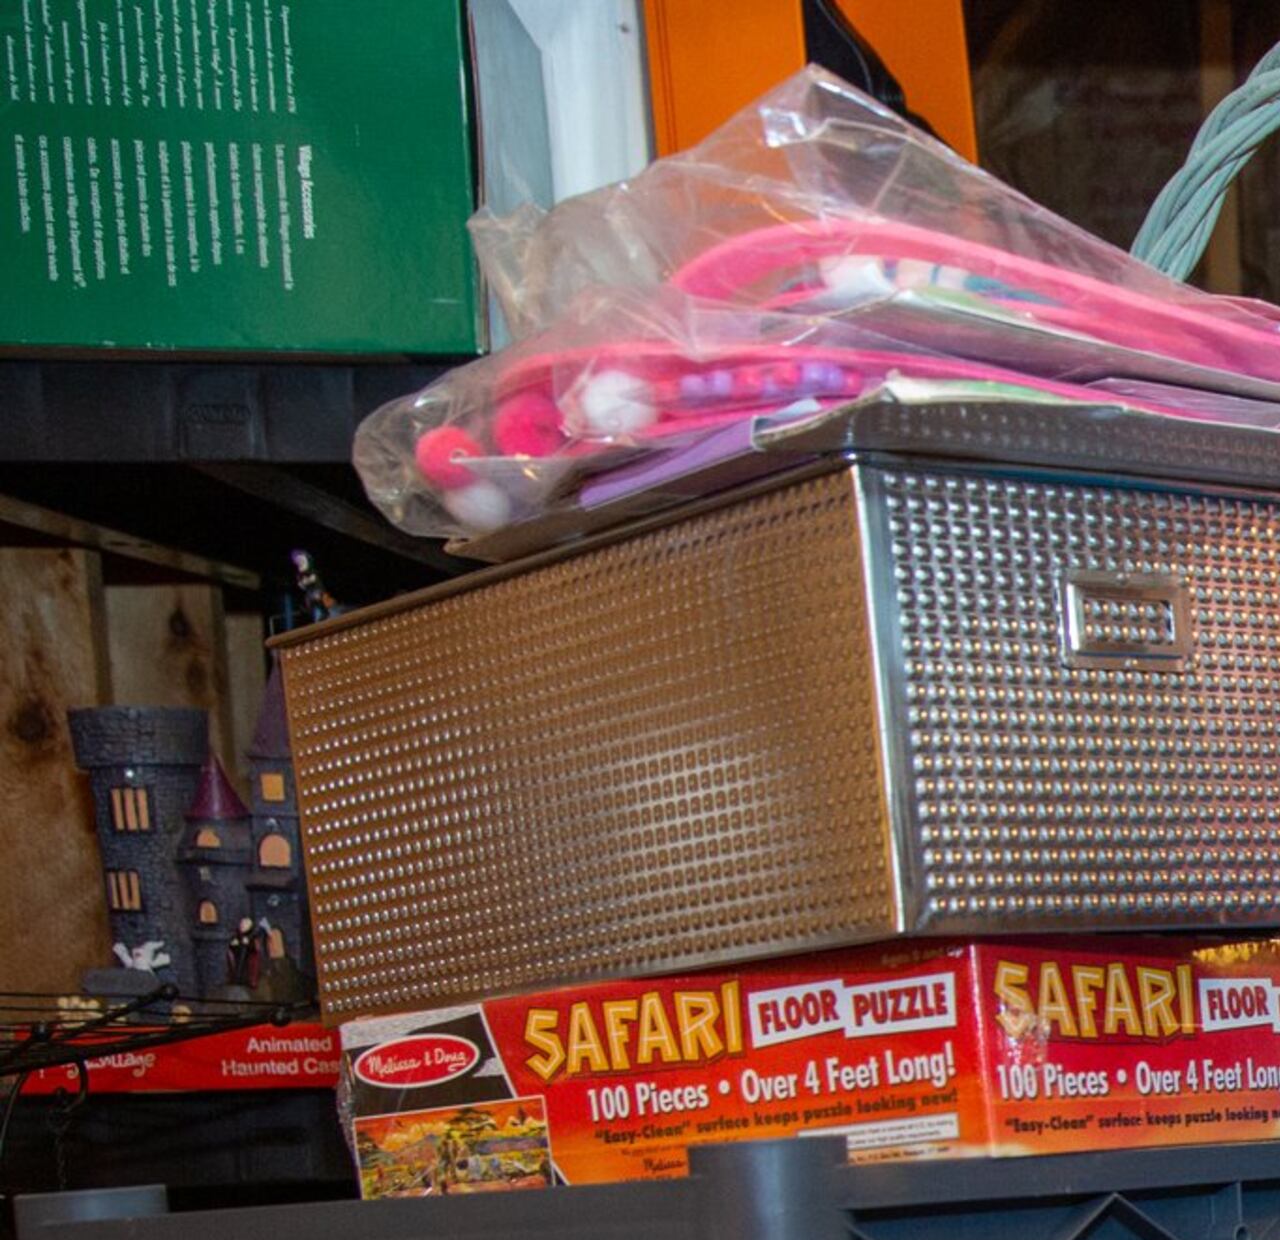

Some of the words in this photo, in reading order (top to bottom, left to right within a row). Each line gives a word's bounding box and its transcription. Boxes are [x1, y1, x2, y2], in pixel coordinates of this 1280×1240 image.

[994, 961, 1195, 1039] SAFARI
[1206, 986, 1270, 1020] FLOOR
[247, 1037, 333, 1054] Animated
[523, 980, 744, 1082] SAFARI
[758, 989, 840, 1035] FLOOR
[852, 982, 949, 1027] PUZZLE
[222, 1058, 299, 1077] Haunted
[366, 1055, 421, 1077] Melissa
[434, 1047, 470, 1072] Doug
[587, 1085, 630, 1123] 100
[636, 1081, 710, 1117] Pieces
[741, 1068, 797, 1104] Over
[804, 1060, 820, 1095] 4
[826, 1054, 880, 1093] Feet
[884, 1040, 956, 1088] Long!
[998, 1065, 1037, 1100] 100
[1043, 1063, 1108, 1097] Pieces
[1136, 1060, 1181, 1095] Over
[1186, 1061, 1198, 1092] 4
[1204, 1058, 1243, 1092] Feet
[696, 1116, 749, 1134] surface
[754, 1110, 799, 1127] keeps
[803, 1101, 853, 1120] puzzle
[857, 1094, 917, 1115] looking
[1147, 1110, 1182, 1128] keeps
[1185, 1108, 1223, 1127] puzzle
[1225, 1105, 1269, 1125] looking
